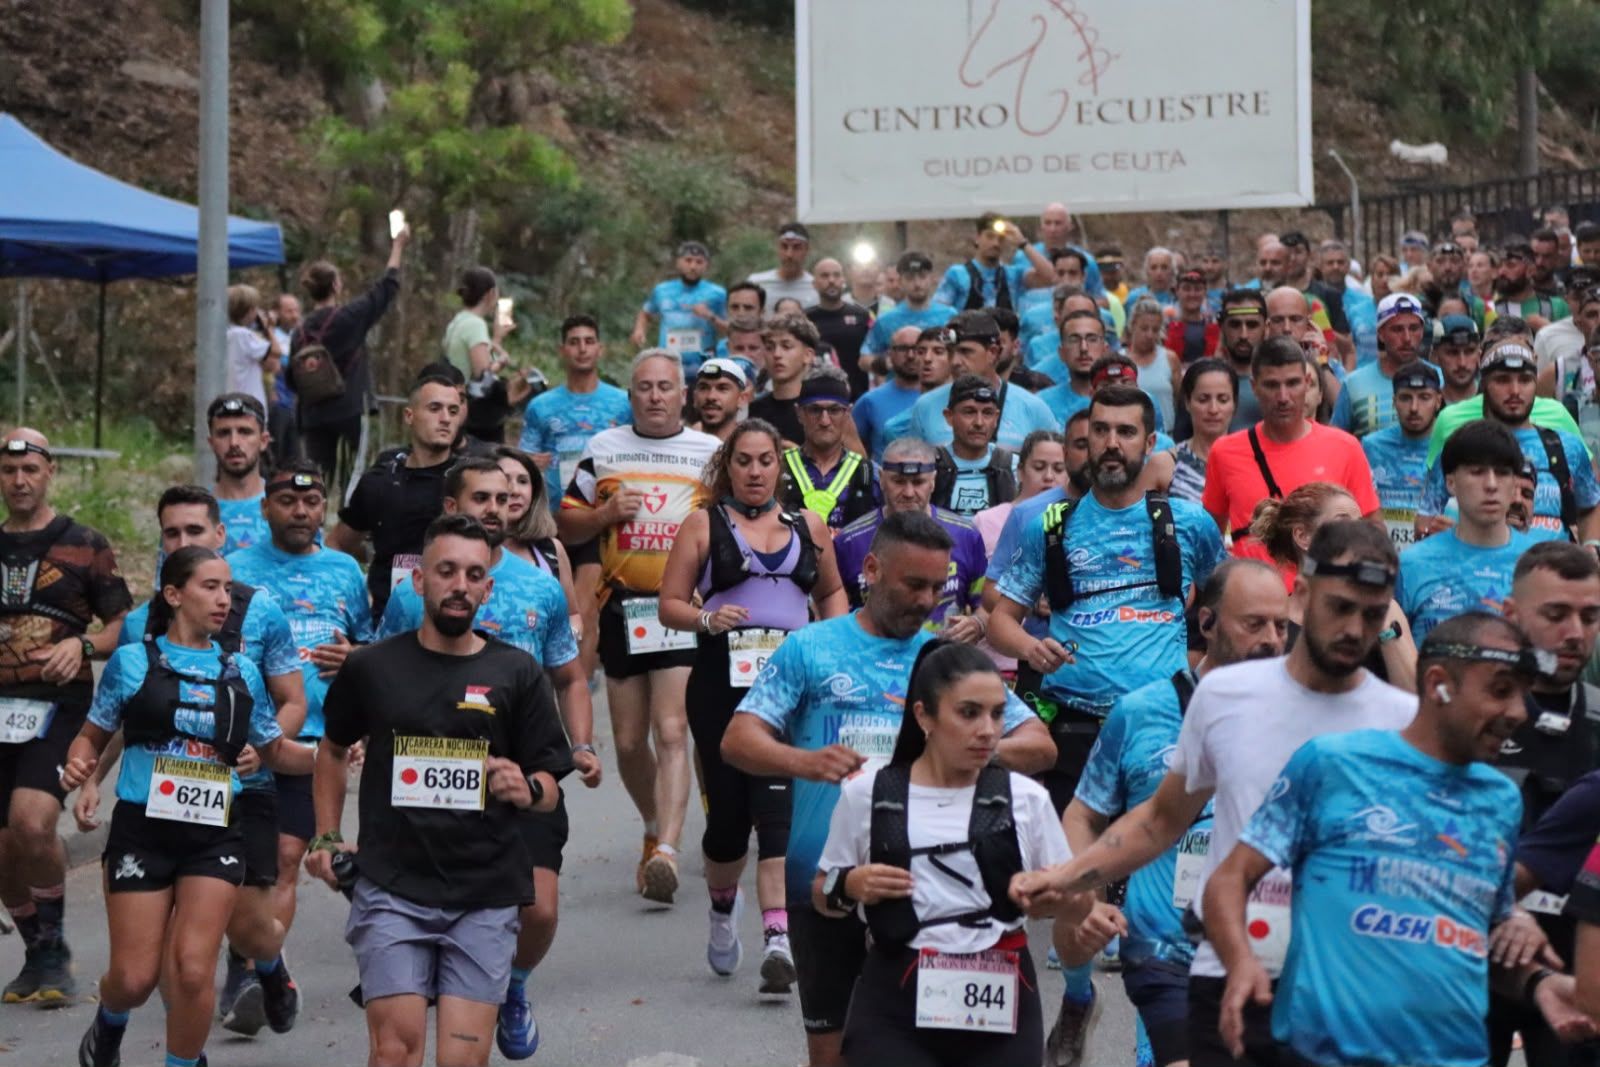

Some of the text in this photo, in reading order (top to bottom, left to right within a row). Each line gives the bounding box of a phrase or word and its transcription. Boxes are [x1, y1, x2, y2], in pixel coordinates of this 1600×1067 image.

[843, 90, 1271, 134] CENTRO ECUESTRE
[923, 149, 1187, 177] CIUDAD DE CEUTA
[630, 536, 674, 551] STAR
[1071, 609, 1118, 627] CASH
[5, 712, 38, 730] 428
[394, 736, 487, 756] IX CARRERA NOCTURNA
[155, 756, 167, 774] IX
[424, 767, 480, 791] 636B
[177, 785, 225, 810] 621A
[1354, 906, 1432, 941] CASH
[963, 982, 1006, 1011] 844
